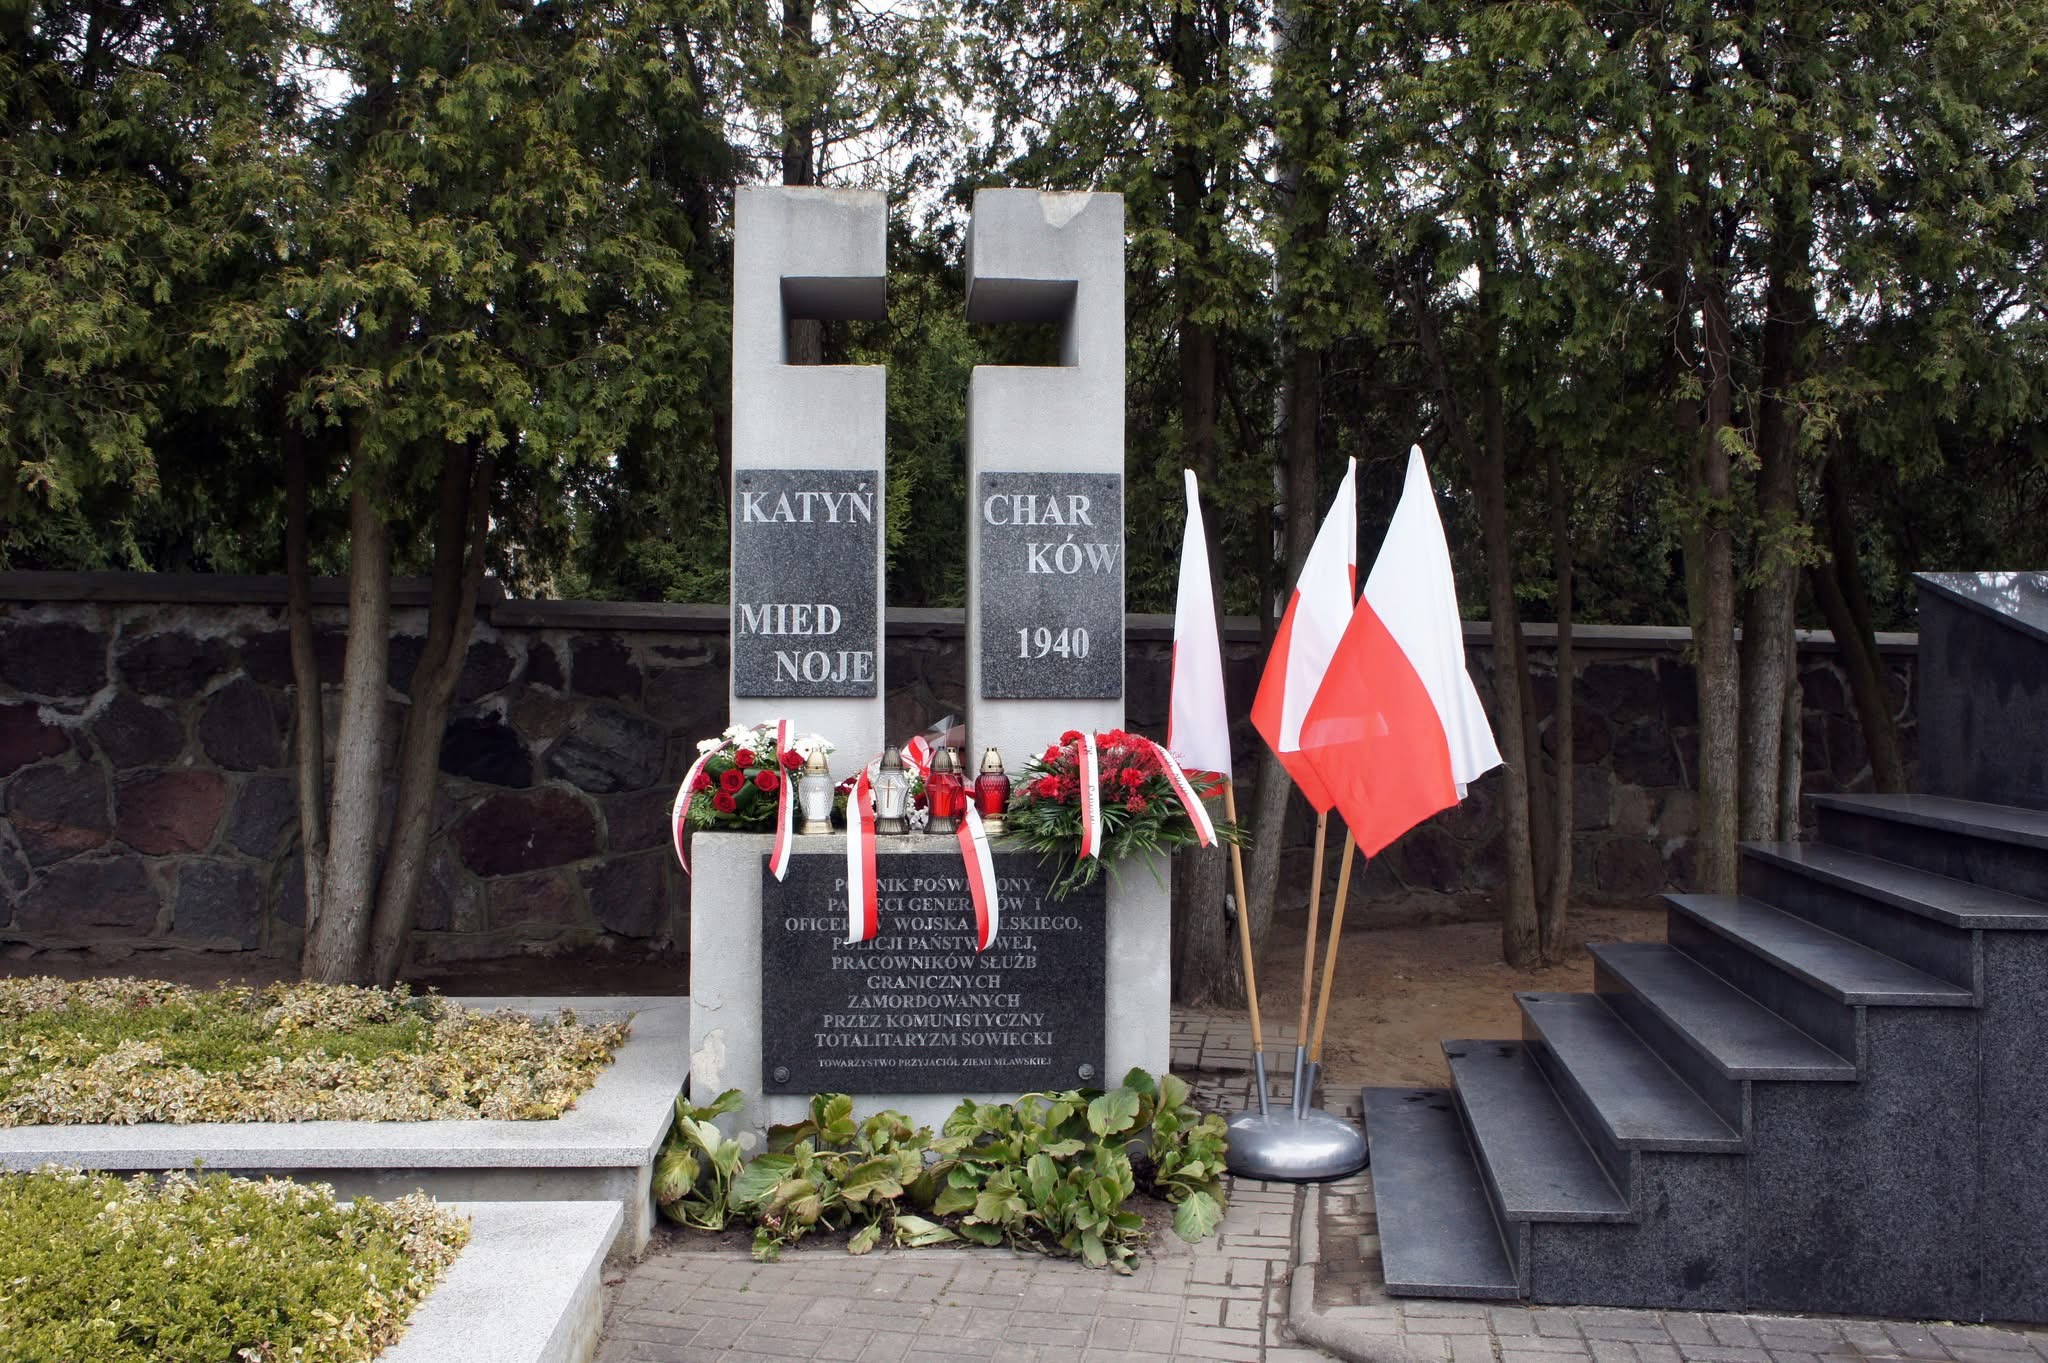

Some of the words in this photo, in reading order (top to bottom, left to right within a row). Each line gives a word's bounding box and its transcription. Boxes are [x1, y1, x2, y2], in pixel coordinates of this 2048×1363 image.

[741, 482, 874, 524] KATYŃ
[983, 494, 1092, 526] CHAR
[1026, 534, 1120, 575] KÓW
[739, 603, 841, 636] MIED
[1017, 627, 1090, 660] 1940
[773, 650, 874, 683] NOJE
[835, 878, 909, 892] PNIK
[912, 874, 1034, 892] POŚWIONY
[828, 897, 905, 915] PAĘCI
[908, 895, 1026, 912] GENERÓW
[893, 916, 969, 932] WOJSKA
[976, 915, 1084, 932] LSKIEGO,
[831, 952, 975, 970] PRACOWNIKÓW
[979, 952, 1038, 970] SŁUŻB
[867, 975, 1001, 990] GRANICZNYCH
[847, 993, 1021, 1009] ZAMORDOWANYCH
[823, 1014, 882, 1028] PRZEZ
[887, 1013, 1045, 1028] KOMUNISTYCZNY
[814, 1032, 957, 1047] TOTALITARYZM
[961, 1031, 1053, 1046] SOWIECKI
[819, 1058, 896, 1068] TOWARZYSTWO
